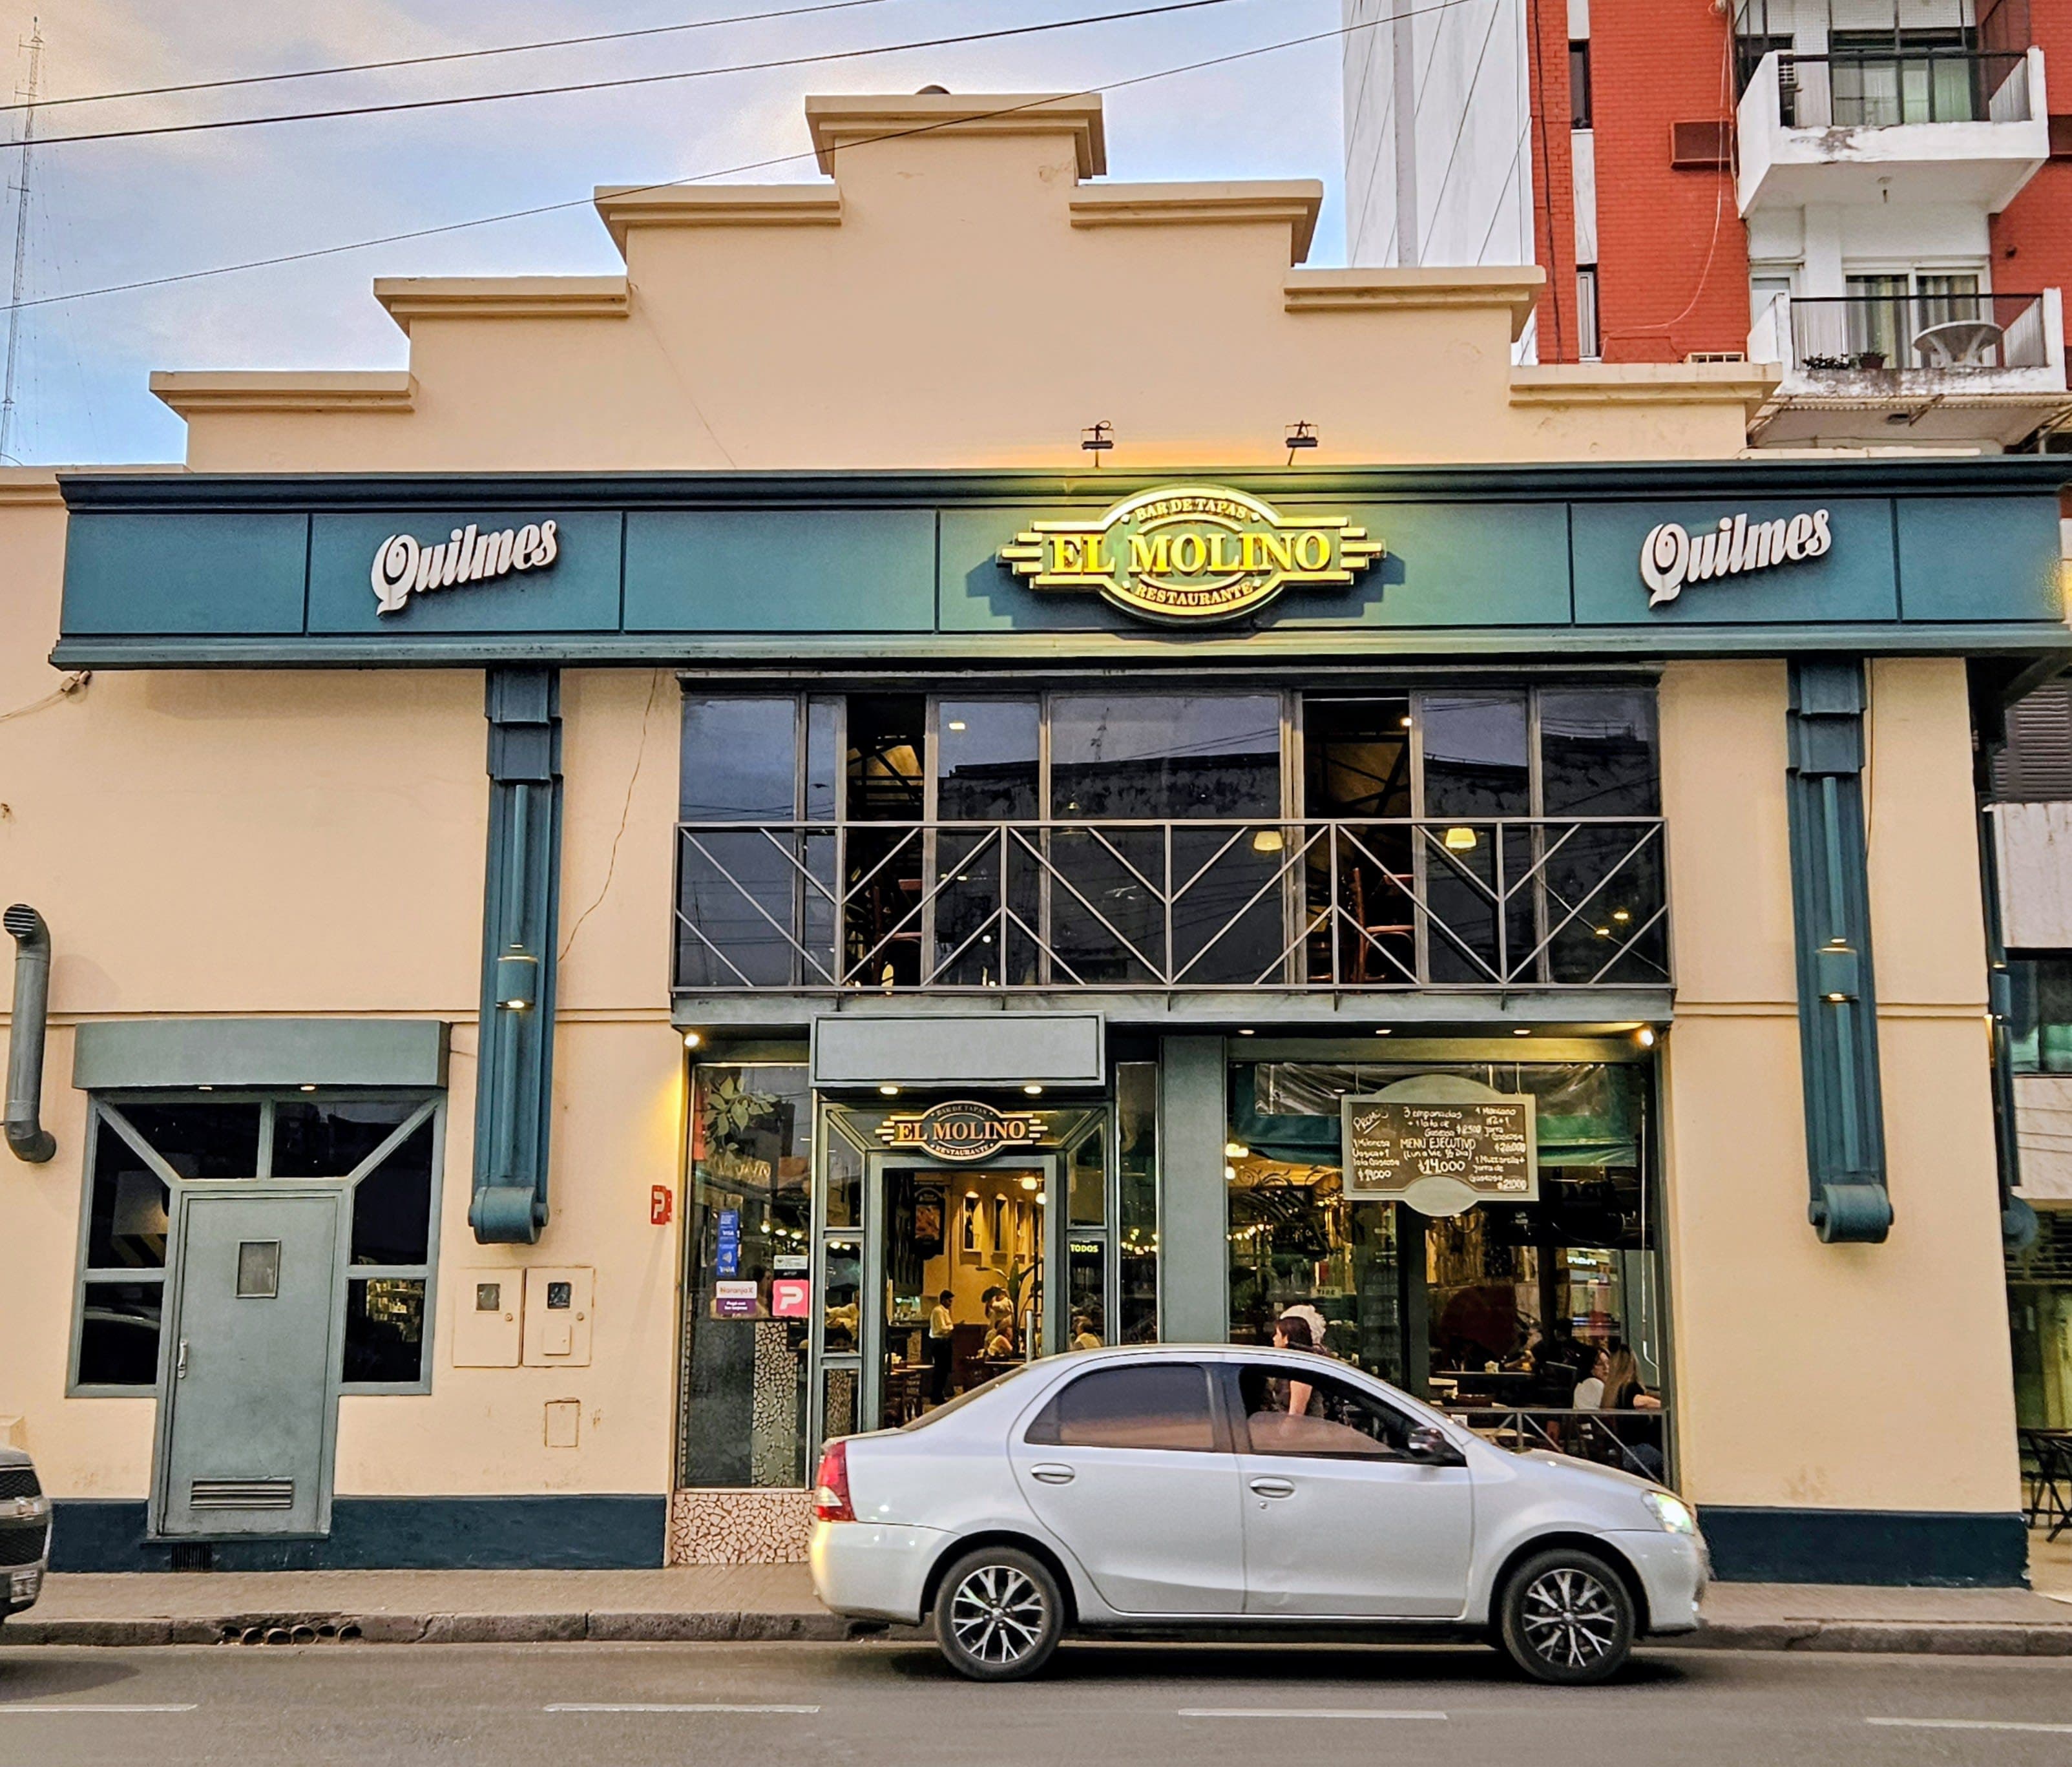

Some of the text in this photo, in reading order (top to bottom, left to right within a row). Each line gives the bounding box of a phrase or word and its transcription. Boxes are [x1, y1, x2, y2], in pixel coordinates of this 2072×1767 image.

[1135, 499, 1248, 521] BAR DE TAPAS
[1049, 530, 1331, 573] EL MOLINO
[1641, 508, 1832, 609] Quilmes
[371, 520, 557, 616] Quilmes
[1135, 581, 1253, 605] RESTAURANTE
[936, 1107, 952, 1116] BAR
[965, 1105, 987, 1114] TAPAS
[1403, 1105, 1411, 1118] 3
[897, 1120, 1026, 1141] EL MOLINO
[936, 1145, 989, 1156] RESTAURANTE
[1429, 1137, 1476, 1150] EJECUTIVO
[1070, 1244, 1099, 1253] TODOS
